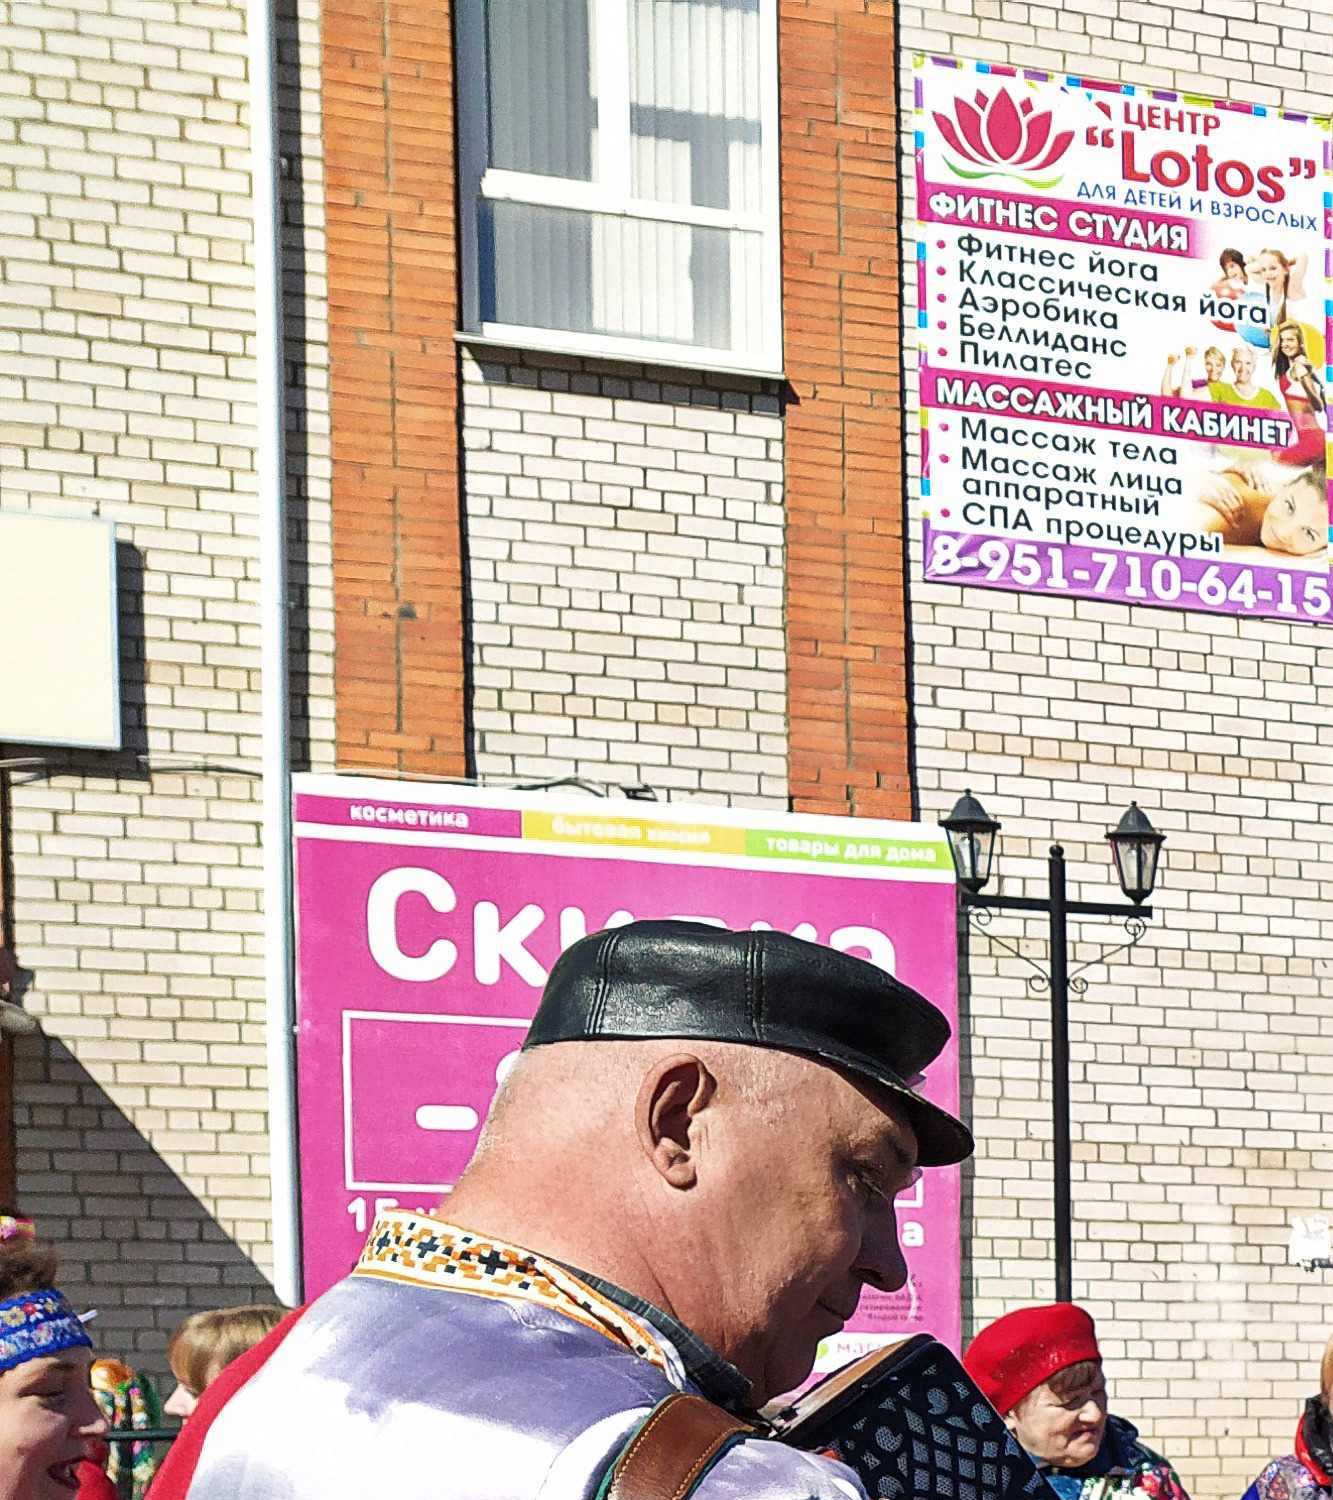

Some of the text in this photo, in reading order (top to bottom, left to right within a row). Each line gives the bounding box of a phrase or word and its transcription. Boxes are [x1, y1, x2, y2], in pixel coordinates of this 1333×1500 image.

[1123, 101, 1221, 136] ЦЕНТР
[928, 193, 1190, 253] ФИТНЕС СТУДИЯ
[1077, 181, 1318, 232] ДЛЯ ДЕТЕЙ И ВЗРОСЛЫХ
[957, 233, 1159, 283] Фитнес йога
[958, 259, 1269, 325] Классическая йога
[958, 287, 1119, 330] Аэробика
[959, 313, 1128, 358] Беллиданс
[959, 341, 1092, 380] Пилатес
[936, 377, 1293, 447] МАССАЖНЫЙ КАБИНЕТ
[961, 417, 1178, 465] Массаж тела
[962, 446, 1183, 497] Массаж лица
[963, 475, 1160, 517] аппаратный
[963, 501, 1221, 557] СПА процедуры
[932, 535, 1332, 617] 8-951-710-64-15
[350, 803, 470, 829] косметика
[766, 835, 840, 857] товары
[844, 843, 883, 860] для
[886, 845, 937, 863] дома
